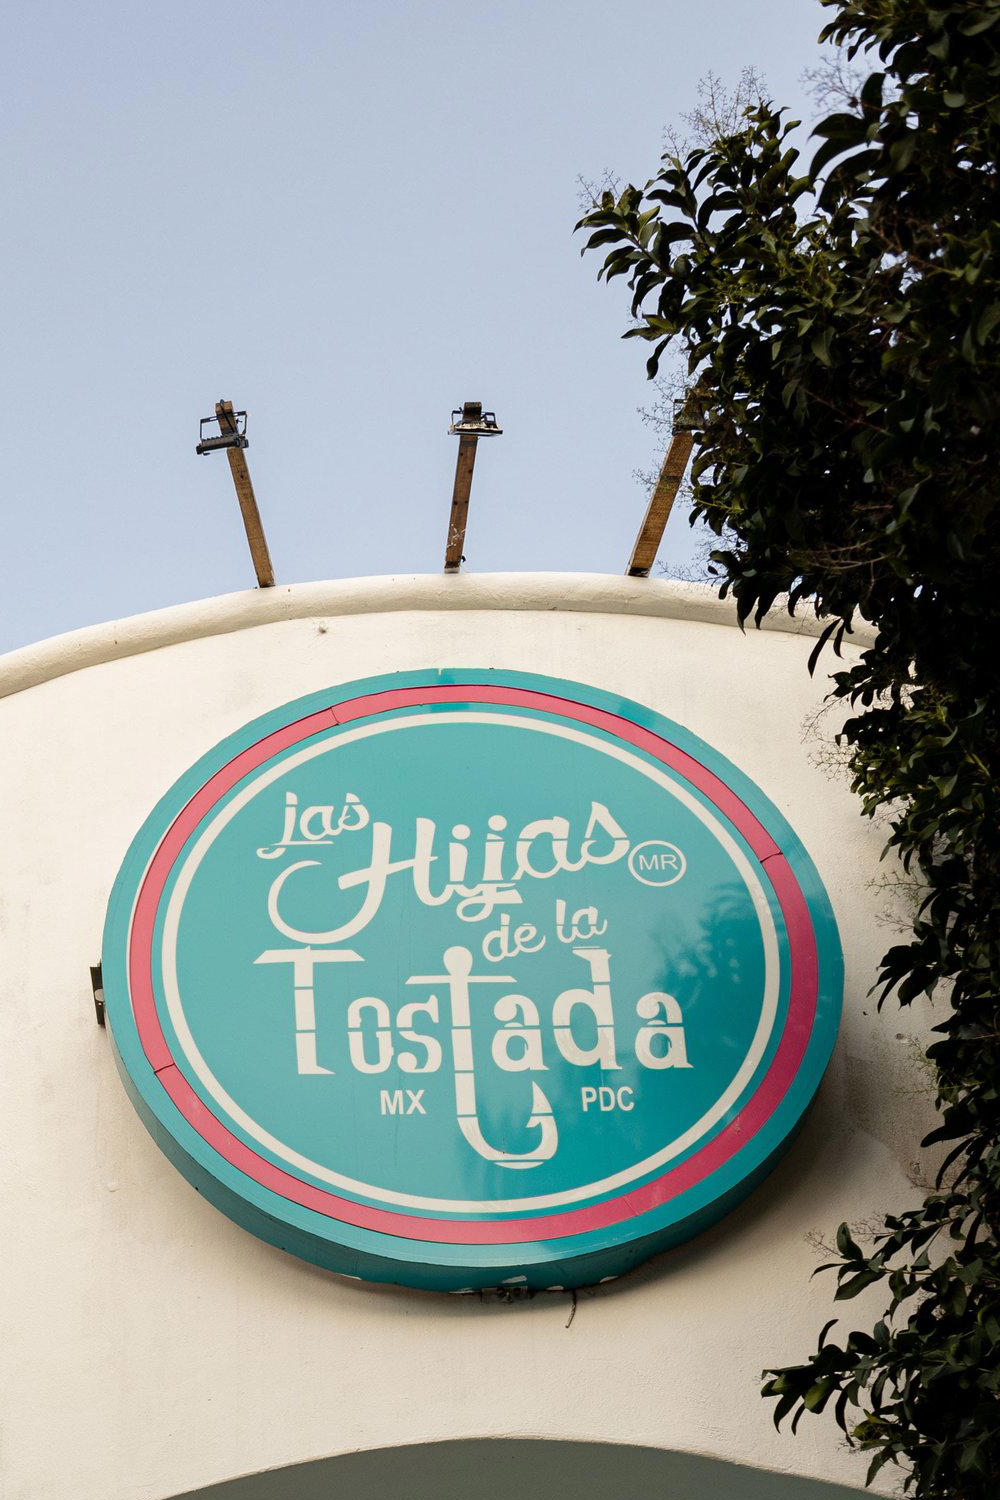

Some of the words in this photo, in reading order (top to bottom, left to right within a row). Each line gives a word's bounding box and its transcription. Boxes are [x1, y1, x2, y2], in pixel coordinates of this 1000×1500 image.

[268, 802, 630, 944] Hijas
[638, 853, 679, 872] MR
[483, 914, 548, 963] de
[556, 900, 607, 940] la
[253, 946, 694, 1169] Tostada
[380, 1090, 426, 1116] MX
[582, 1086, 635, 1112] PDC
